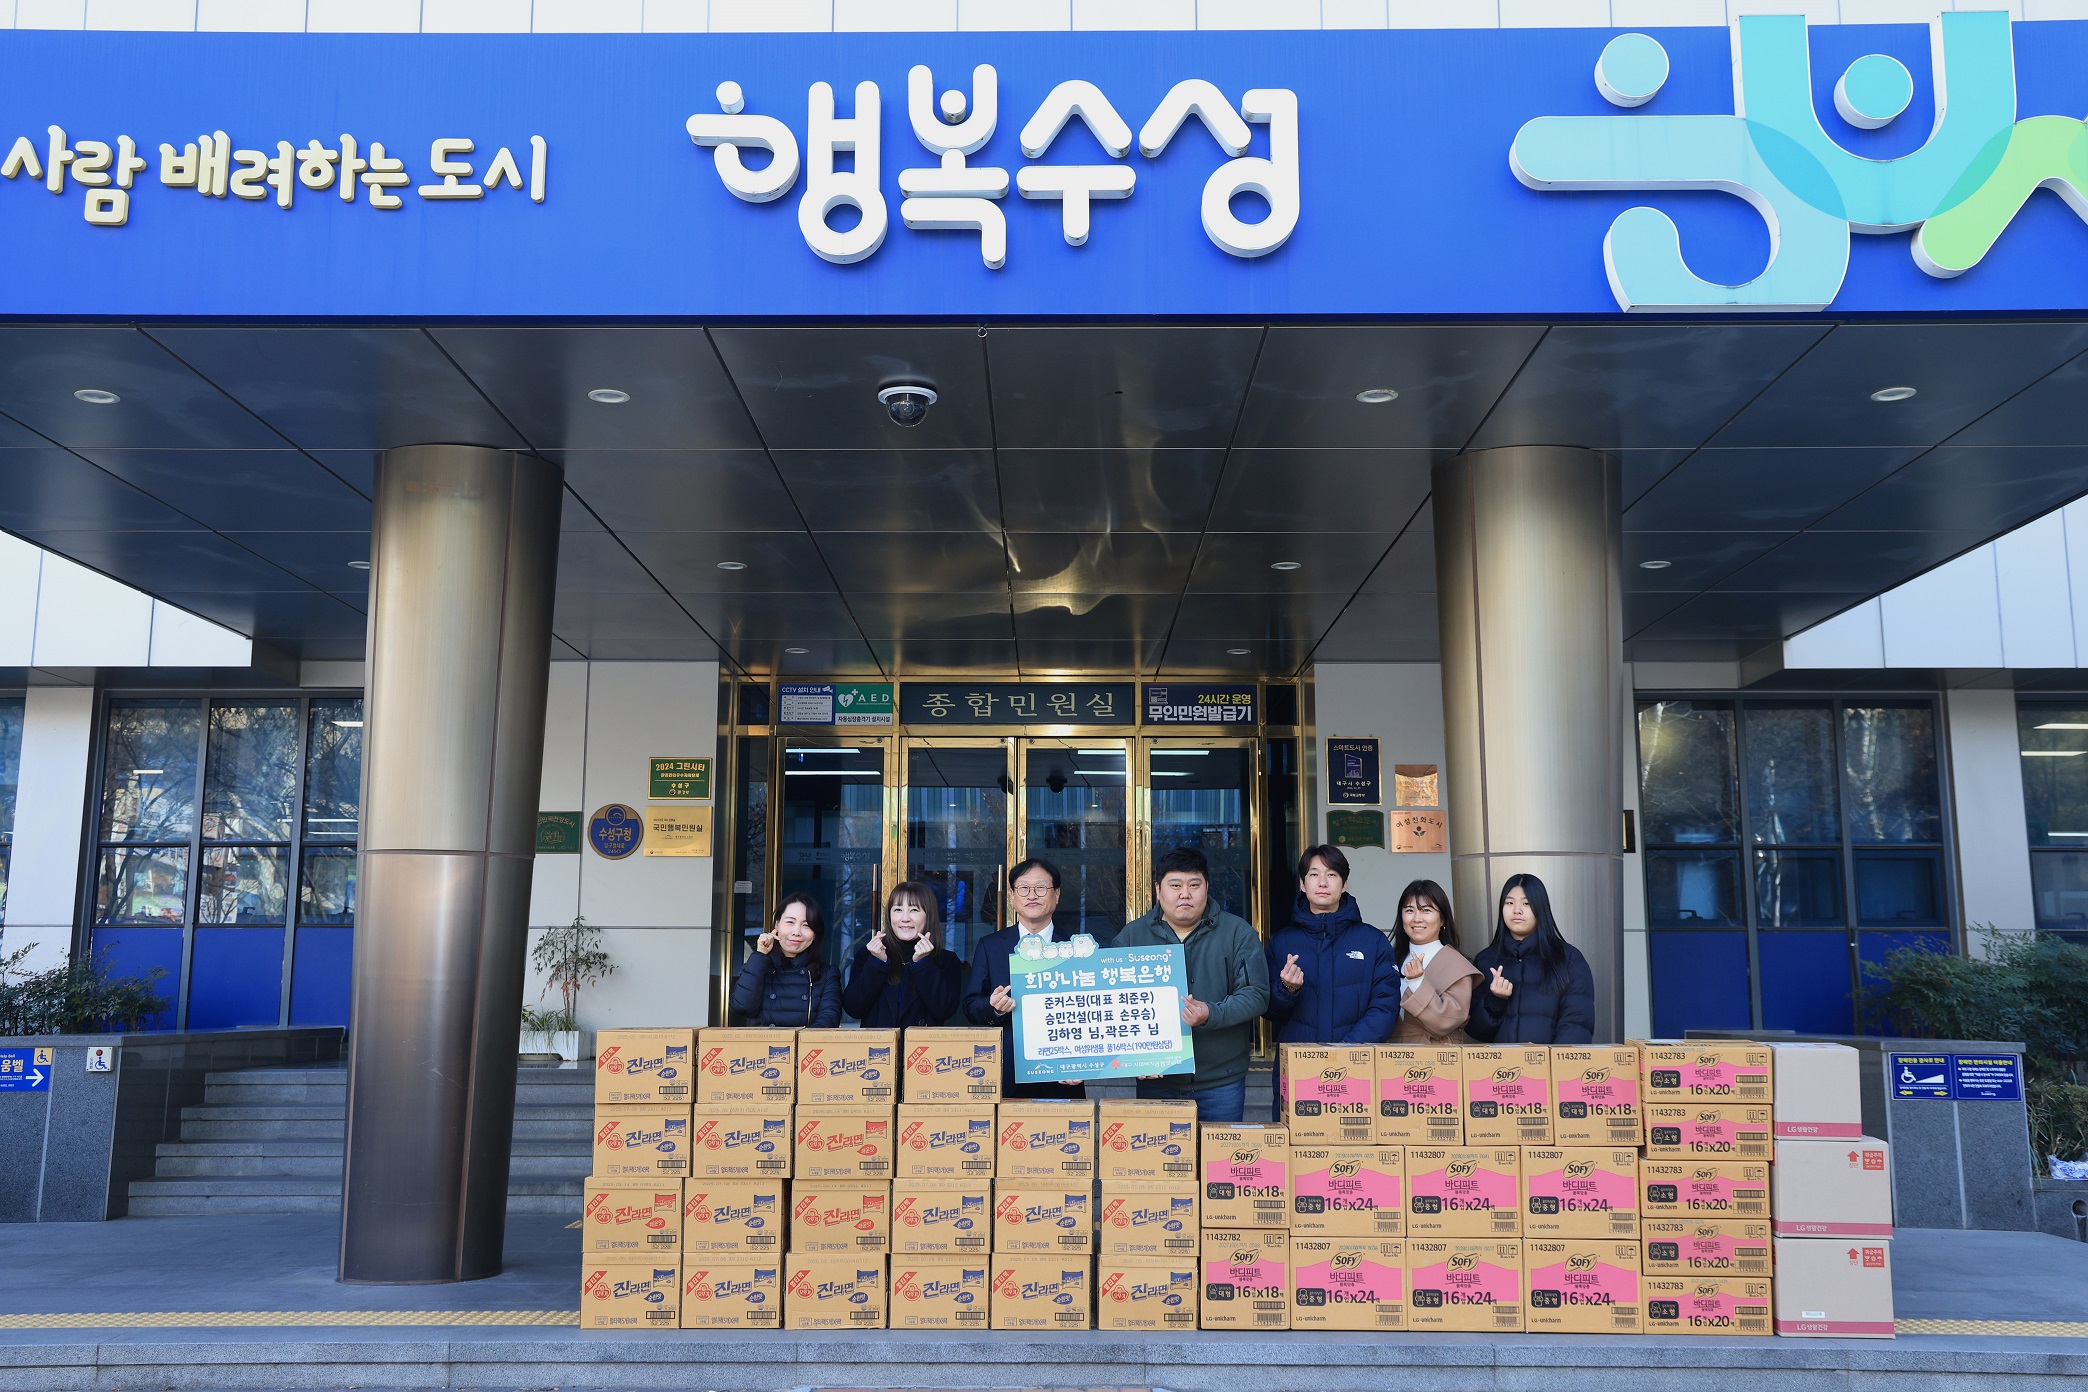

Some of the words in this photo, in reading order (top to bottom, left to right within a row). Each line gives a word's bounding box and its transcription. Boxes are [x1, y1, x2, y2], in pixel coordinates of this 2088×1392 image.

[686, 63, 1300, 269] 행복수성
[1, 125, 147, 225] 사람
[160, 130, 409, 209] 배려하는
[418, 135, 546, 203] 도시
[858, 694, 890, 702] AED
[1197, 694, 1230, 705] 24시간
[1232, 693, 1252, 705] 운영
[922, 692, 1116, 717] 종합민원실
[1148, 705, 1252, 722] 무인민원발급기
[655, 762, 675, 771] 2024
[676, 762, 705, 772] 그린시티
[652, 823, 703, 833] 국민행복민원실
[599, 827, 632, 842] 수성구청
[1128, 953, 1169, 963] Suseong
[1024, 969, 1096, 990] 희망나눔
[1100, 964, 1172, 986] 행복은행
[1118, 991, 1154, 1005] 최준우)
[1120, 1007, 1156, 1022] 손우승)
[1047, 1027, 1082, 1042] 김하영
[1148, 1023, 1159, 1036] 님
[1294, 1051, 1329, 1059] 11432782
[1380, 1051, 1415, 1059] 11432782
[1467, 1052, 1502, 1060] 11432782
[1650, 1052, 1685, 1060] 11432783
[626, 1057, 664, 1075] 진라면
[729, 1057, 767, 1075] 진라면
[829, 1058, 867, 1076] 진라면
[934, 1056, 972, 1074] 진라면
[1323, 1070, 1343, 1080] SOFY
[1408, 1069, 1428, 1079] SOFY
[1496, 1070, 1516, 1080] SOFY
[1585, 1070, 1605, 1080] SOFY
[1318, 1084, 1348, 1093] 바디피트
[1403, 1084, 1435, 1094] 바디피트
[1492, 1085, 1525, 1094] 바디피트
[1581, 1086, 1614, 1095] 바디피트
[1699, 1113, 1717, 1121] SOFY
[625, 1130, 663, 1149] 진라면
[724, 1130, 762, 1149] 진라면
[929, 1131, 967, 1149] 진라면
[1029, 1131, 1067, 1149] 진라면
[1130, 1133, 1168, 1151] 진라면
[1206, 1133, 1242, 1141] 11432782
[826, 1133, 864, 1152] 진라면
[1234, 1152, 1254, 1162] SOFY
[1294, 1151, 1329, 1159] 11432807
[1410, 1151, 1446, 1159] 11432807
[1528, 1151, 1563, 1159] 11432807
[1230, 1167, 1262, 1177] 바디피트
[1334, 1164, 1355, 1173] SOFY
[1450, 1164, 1471, 1174] SOFY
[1568, 1164, 1589, 1174] SOFY
[1647, 1166, 1683, 1174] 11432783
[1696, 1170, 1714, 1178] SOFY
[1328, 1180, 1363, 1190] 바디피트
[1444, 1180, 1479, 1190] 바디피트
[1562, 1180, 1597, 1190] 바디피트
[1692, 1183, 1719, 1191] 바디피트
[614, 1206, 652, 1225] 진라면
[713, 1206, 751, 1224] 진라면
[823, 1208, 861, 1226] 진라면
[923, 1207, 960, 1225] 진라면
[1025, 1205, 1062, 1224] 진라면
[1131, 1209, 1169, 1227] 진라면
[1697, 1228, 1715, 1236] SOFY
[1412, 1243, 1447, 1252] 11432807
[1530, 1244, 1565, 1252] 11432807
[1693, 1241, 1721, 1249] 바디피트
[1233, 1252, 1254, 1262] SOFY
[1335, 1256, 1356, 1266] SOFY
[1451, 1257, 1473, 1267] SOFY
[1570, 1257, 1591, 1267] SOFY
[1229, 1267, 1262, 1277] 바디피트
[1329, 1272, 1364, 1282] 바디피트
[1446, 1273, 1481, 1283] 바디피트
[1564, 1273, 1600, 1284] 바디피트
[613, 1280, 651, 1299] 진라면
[714, 1280, 752, 1299] 진라면
[817, 1282, 855, 1300] 진라면
[923, 1282, 960, 1299] 진라면
[1021, 1282, 1059, 1300] 진라면
[1648, 1282, 1684, 1290] 11432783
[1130, 1284, 1168, 1302] 진라면
[1693, 1299, 1721, 1307] 바디피트
